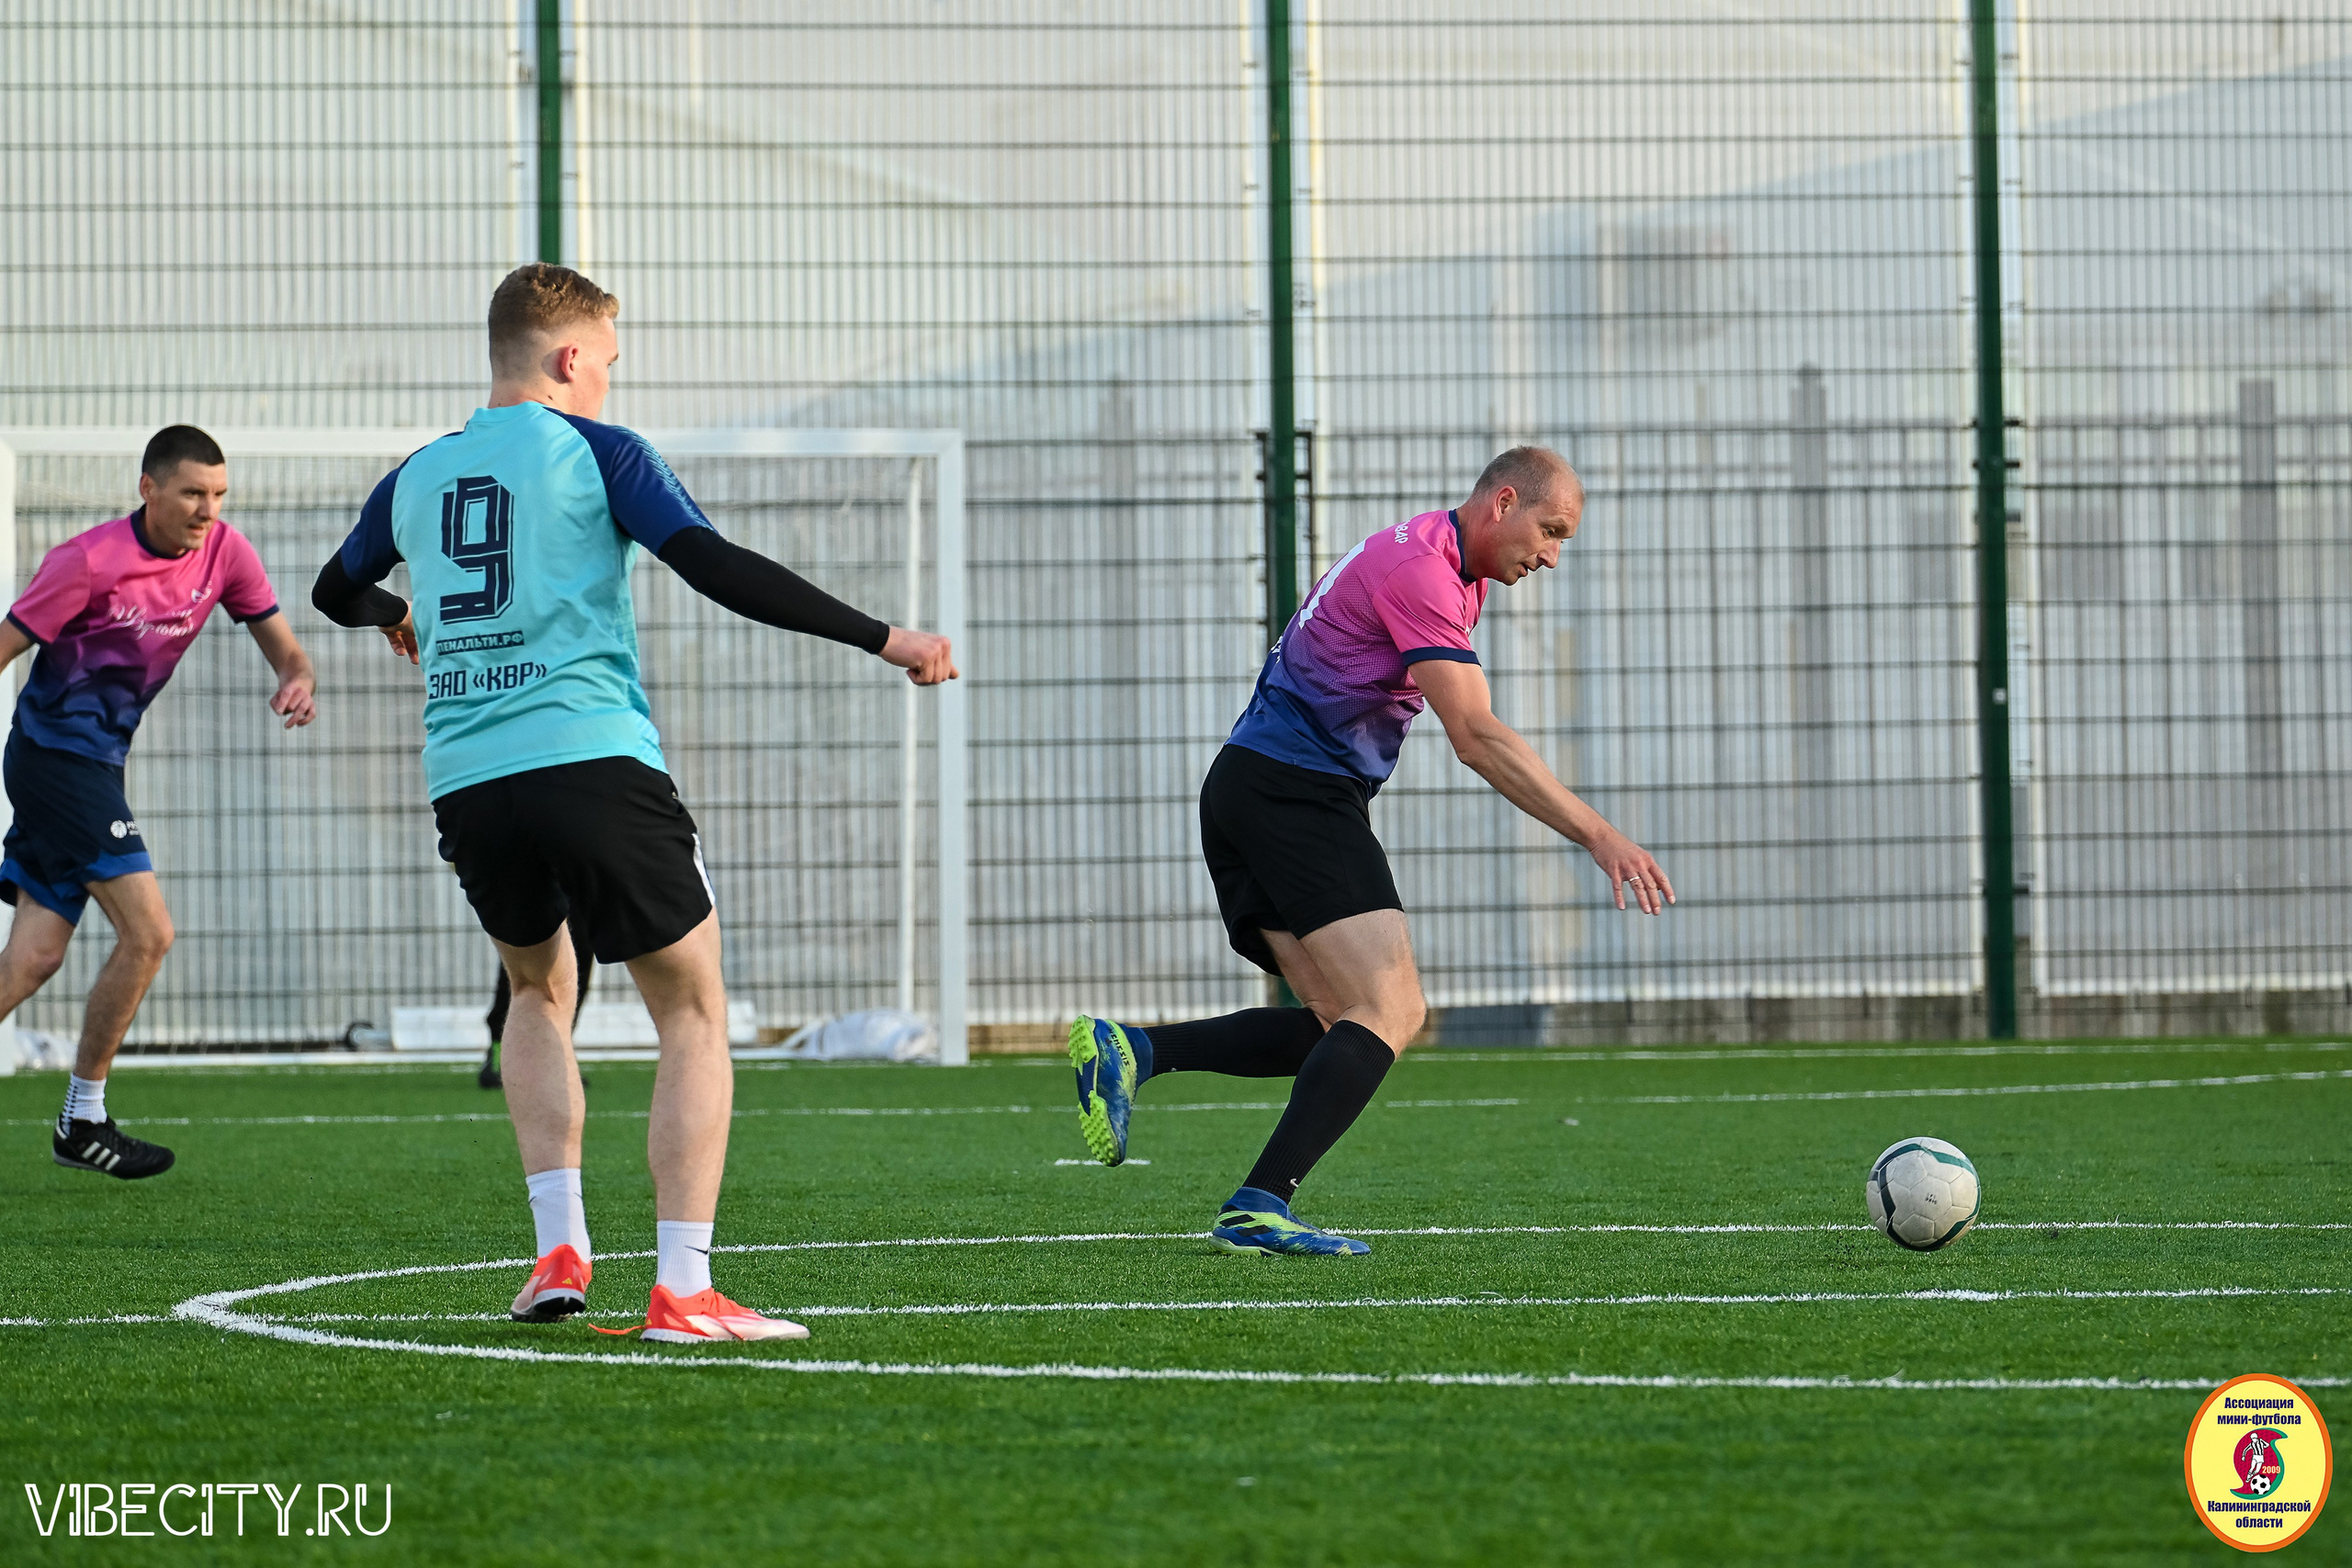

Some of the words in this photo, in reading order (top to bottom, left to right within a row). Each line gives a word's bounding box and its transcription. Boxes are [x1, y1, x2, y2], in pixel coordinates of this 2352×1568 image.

[1394, 519, 1410, 544] ВАР
[440, 475, 514, 626] 9
[436, 632, 524, 654] ПЕНАЛЬТИ.РФ
[428, 670, 467, 699] ЗАО
[472, 661, 548, 692] «КВР»
